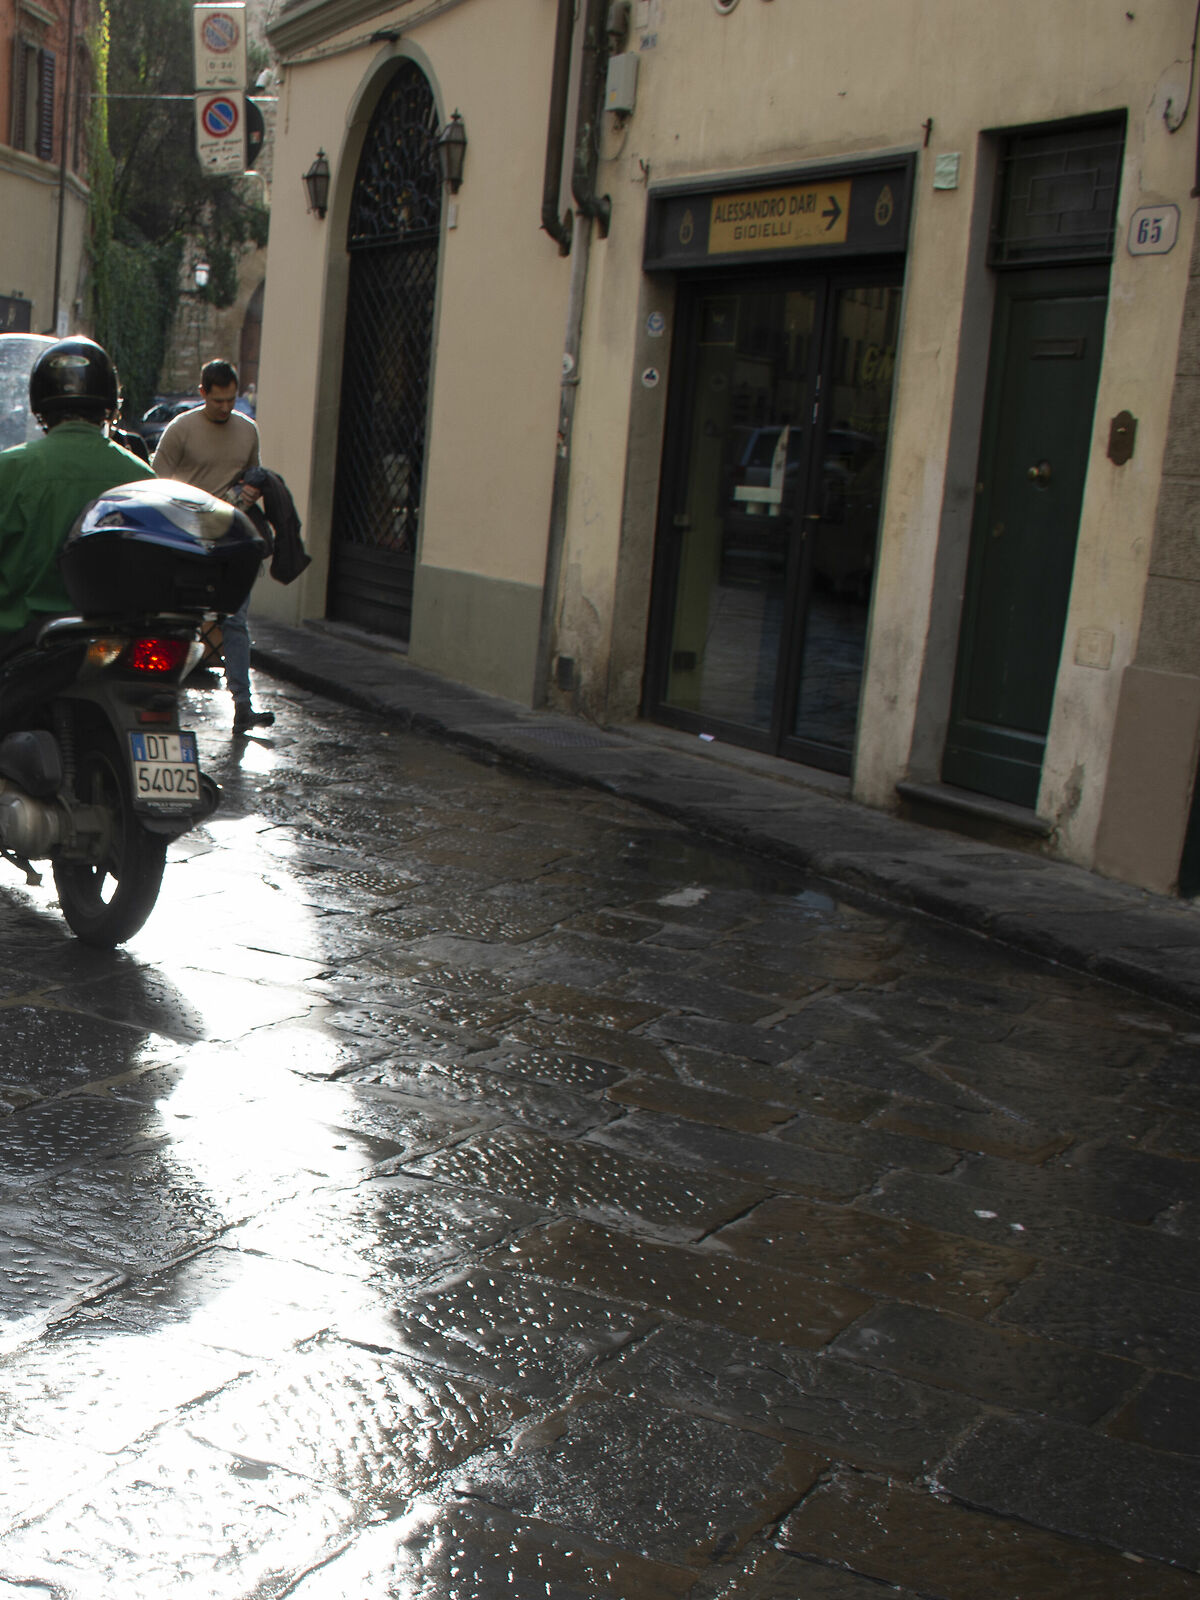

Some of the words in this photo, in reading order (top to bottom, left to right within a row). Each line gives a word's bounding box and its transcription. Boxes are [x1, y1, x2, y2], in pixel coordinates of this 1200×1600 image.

[714, 197, 786, 223] ALESSANDRO
[789, 193, 817, 215] DARI
[733, 221, 792, 240] GIOIELLI
[1137, 218, 1163, 244] 65
[146, 735, 169, 760] DT
[138, 768, 197, 793] 54025
